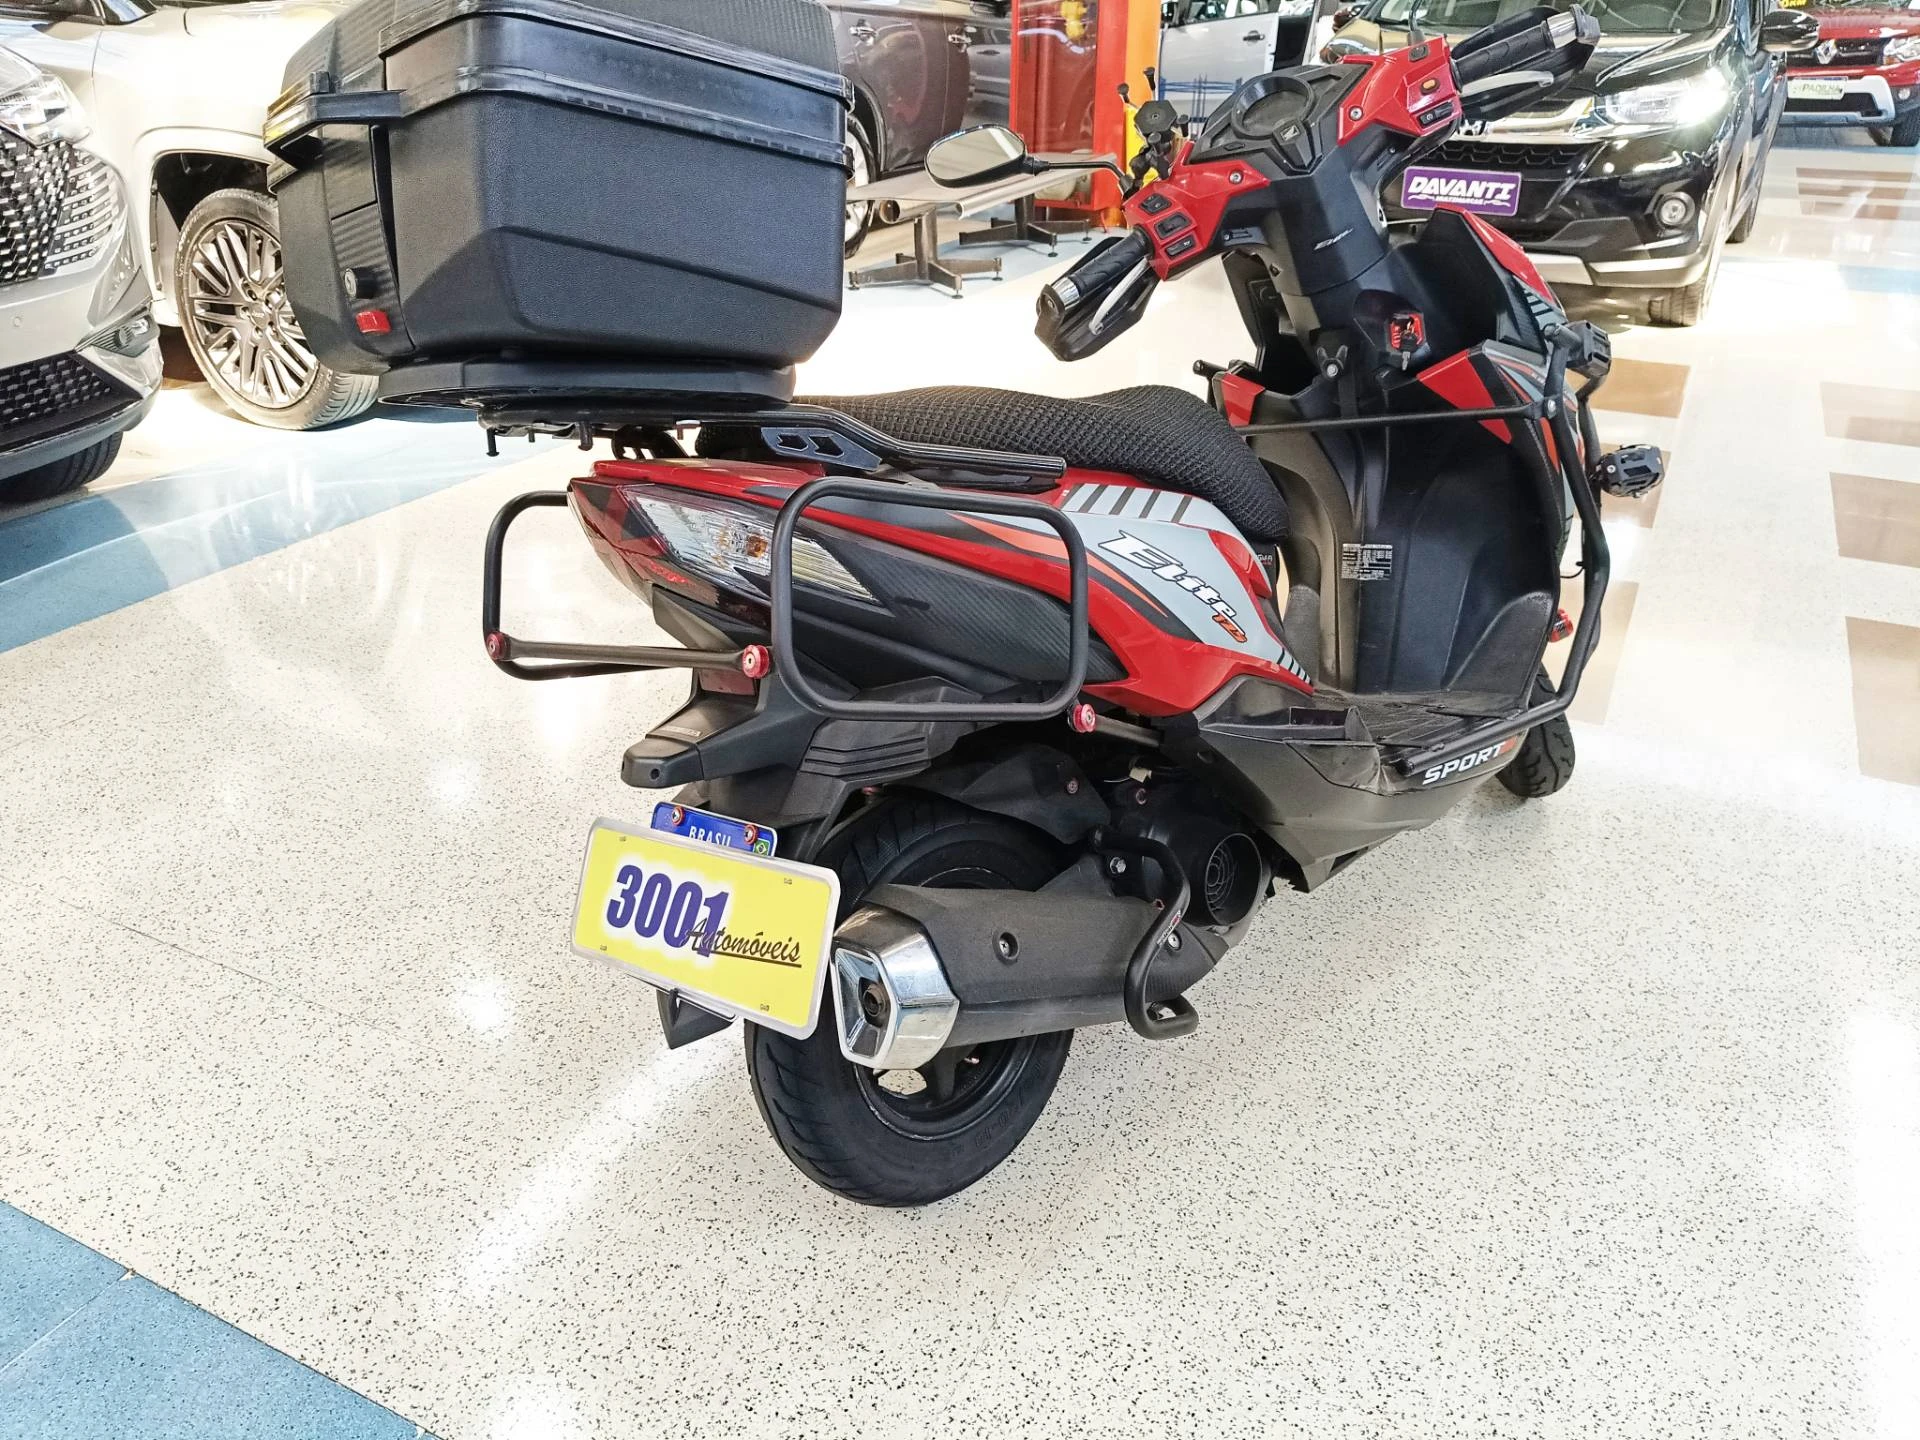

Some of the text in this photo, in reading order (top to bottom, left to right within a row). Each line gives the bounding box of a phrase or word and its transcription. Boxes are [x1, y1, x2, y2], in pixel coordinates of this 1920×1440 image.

[1408, 176, 1516, 200] DAVANTI
[1098, 530, 1246, 630] Elite
[1422, 741, 1507, 785] SPORT
[606, 864, 730, 958] 3001
[686, 918, 801, 964] Automóveis
